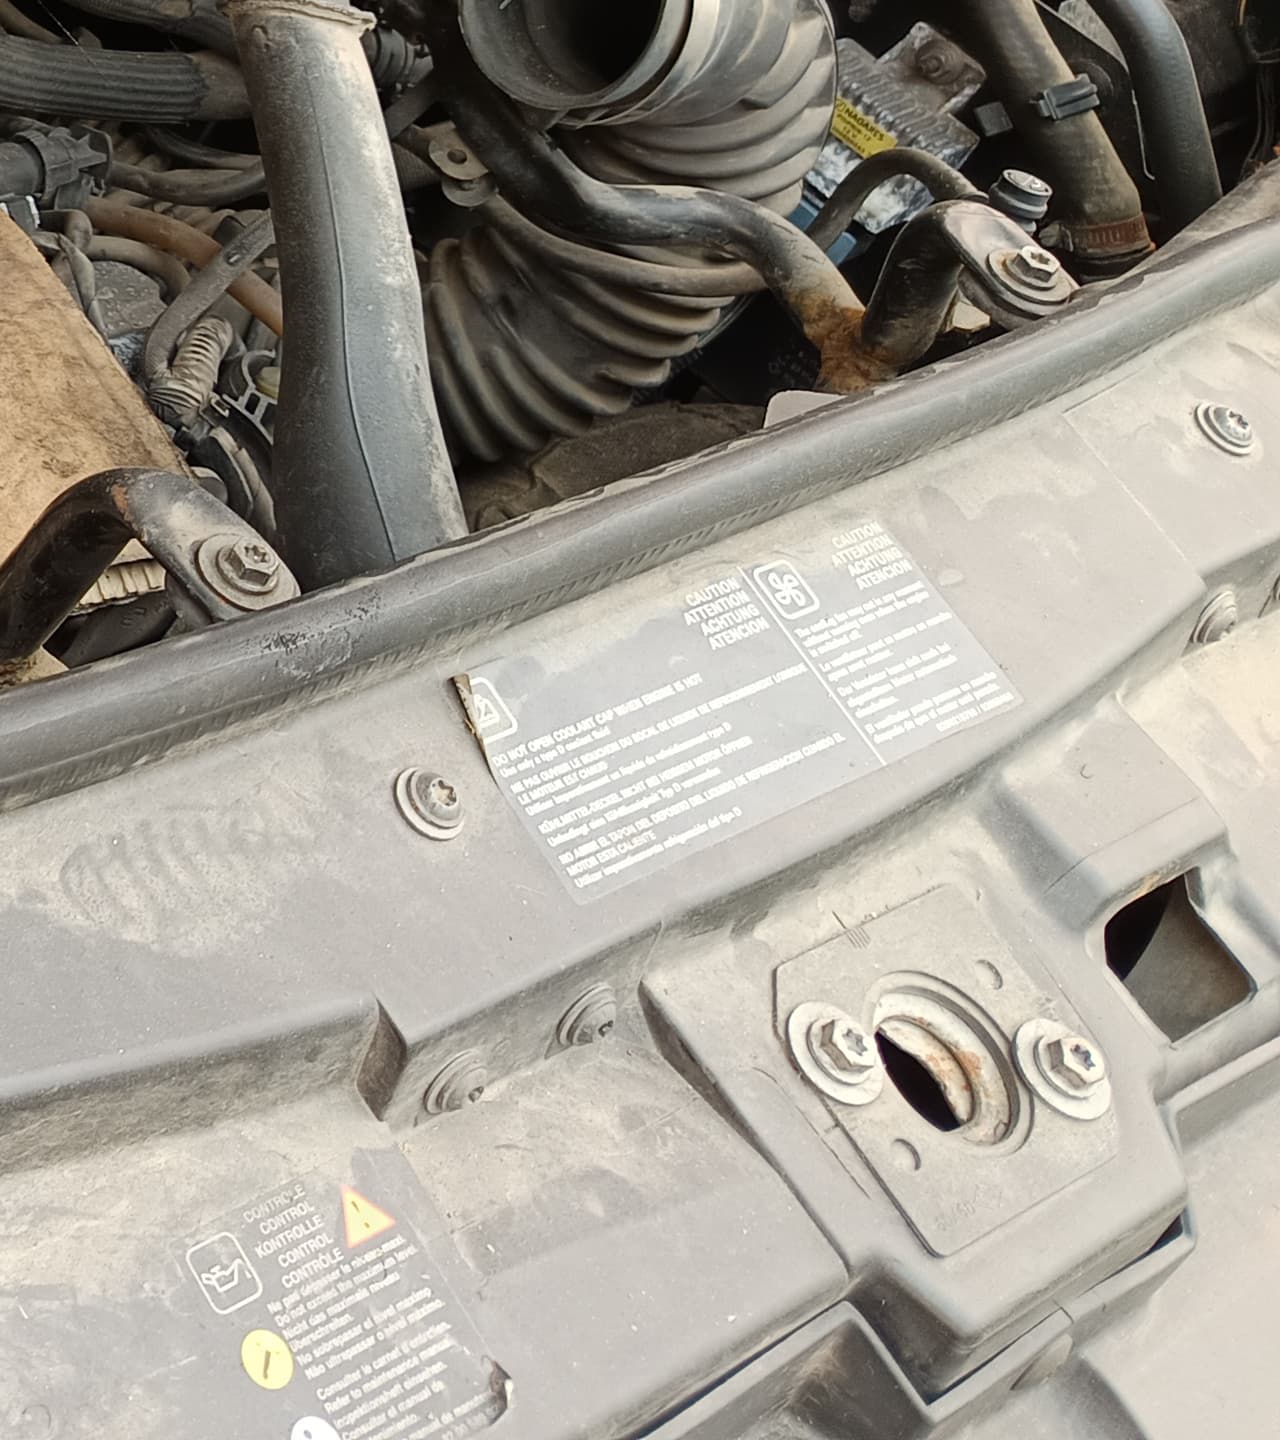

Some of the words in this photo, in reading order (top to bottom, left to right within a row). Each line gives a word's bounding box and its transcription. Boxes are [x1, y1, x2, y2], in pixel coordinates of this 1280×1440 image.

[831, 534, 893, 566] ATTENTION
[832, 521, 883, 548] CAUTION
[847, 546, 903, 576] ACHTUNG
[856, 559, 912, 590] ATENCION
[685, 574, 740, 606] CAUTION
[684, 590, 751, 625] ATTENTION
[701, 603, 760, 635] ACHTUNG
[709, 617, 770, 649] ATENCION
[594, 709, 614, 724] CAP
[259, 1201, 315, 1234] CONTROL
[255, 1214, 325, 1258] KONTROLLE
[278, 1232, 333, 1267] CONTROL
